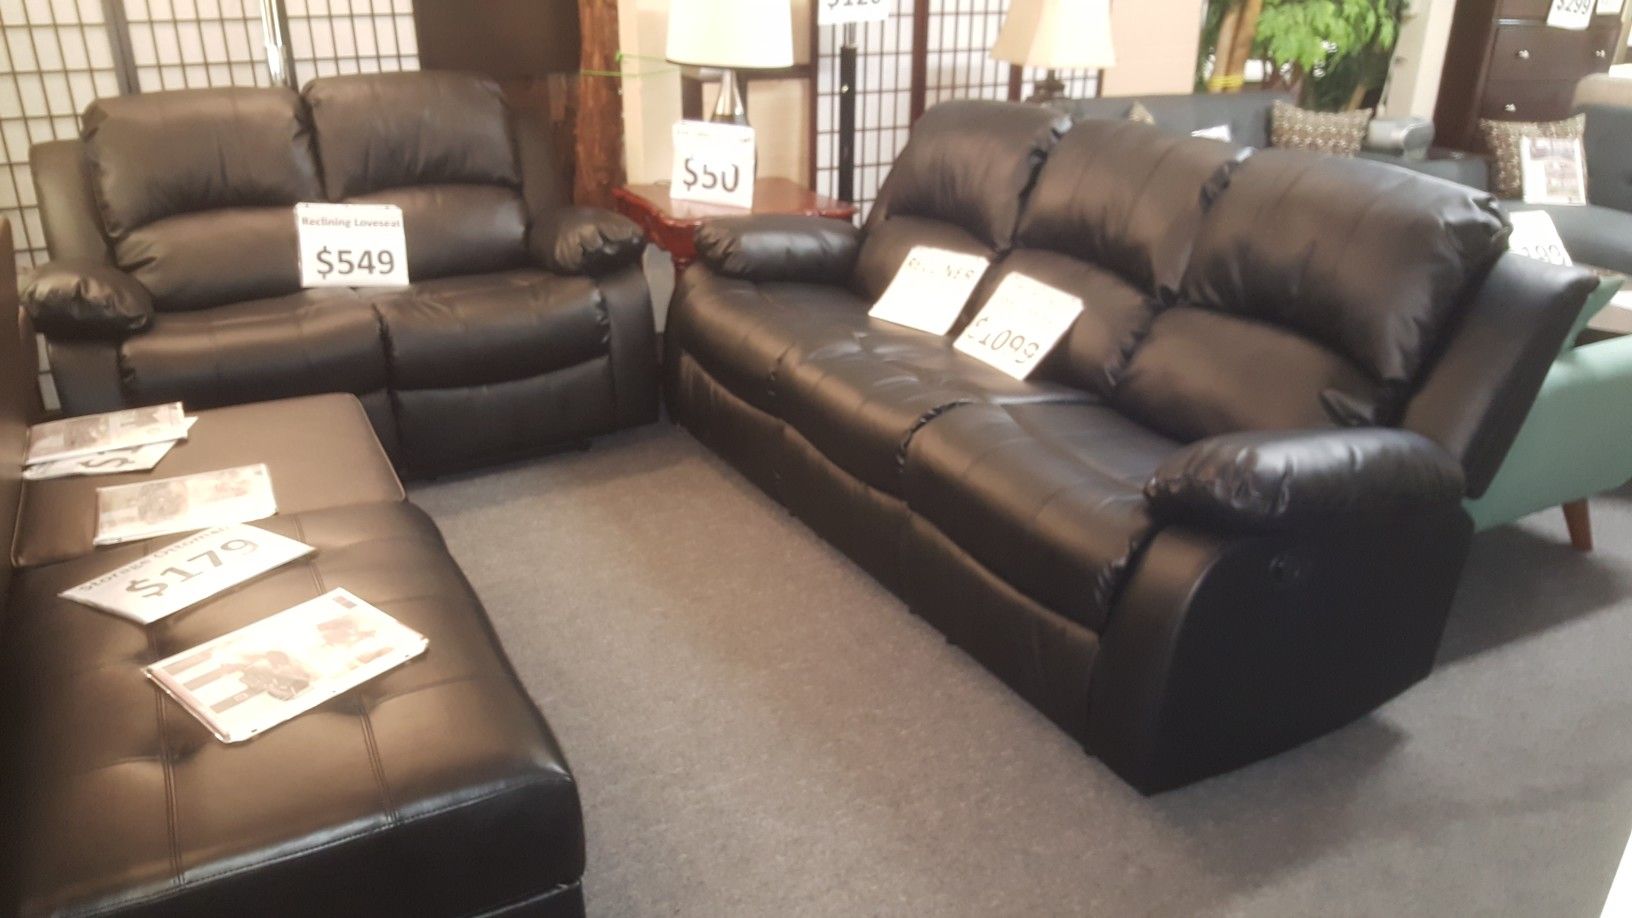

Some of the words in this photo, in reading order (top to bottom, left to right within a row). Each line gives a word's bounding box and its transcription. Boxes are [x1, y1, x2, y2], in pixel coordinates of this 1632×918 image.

[682, 155, 739, 193] $50
[302, 216, 352, 229] Reclining
[354, 218, 400, 228] Loveseat
[316, 245, 395, 280] $549
[908, 257, 975, 280] RNER
[79, 558, 151, 591] Storage
[153, 526, 231, 560] Ottoma
[125, 538, 259, 599] $179
